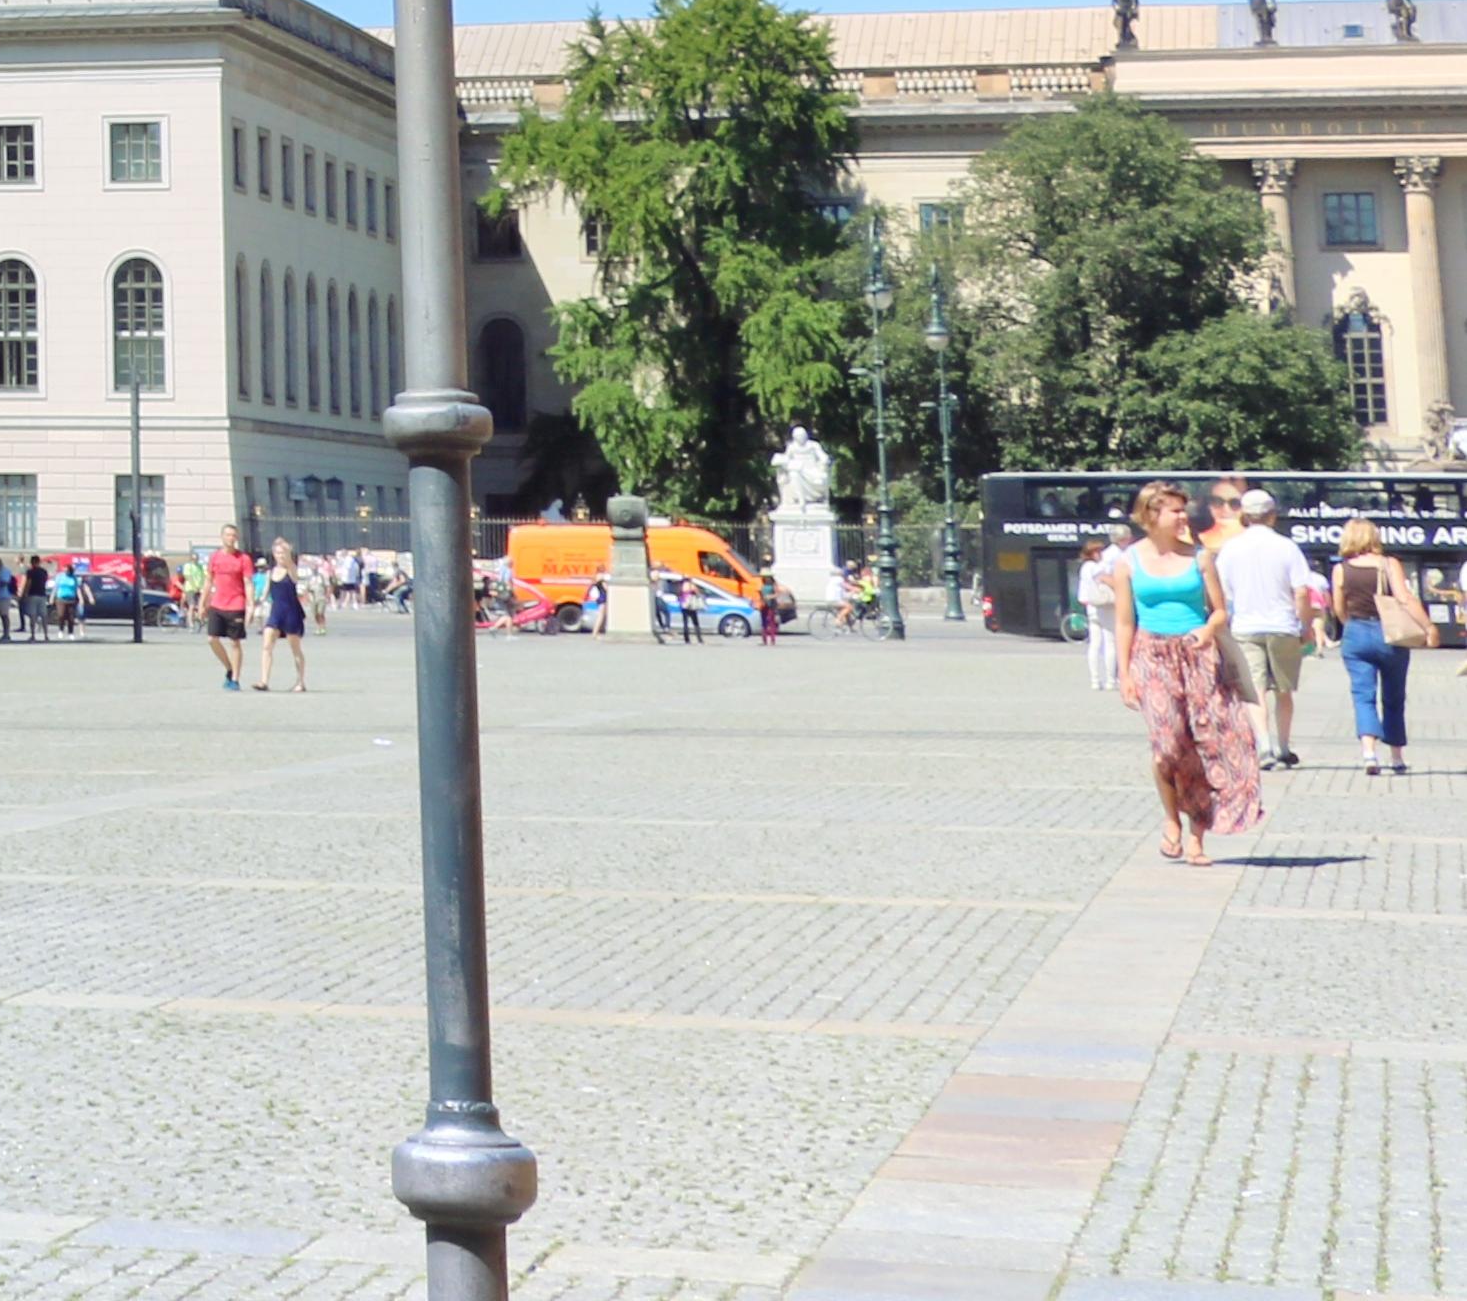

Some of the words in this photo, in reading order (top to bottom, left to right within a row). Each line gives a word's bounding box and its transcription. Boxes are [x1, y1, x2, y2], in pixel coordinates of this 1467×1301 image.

[1212, 119, 1426, 135] HUMBOLDT
[1003, 523, 1078, 534] POTSDAMER
[1079, 523, 1111, 534] PLAT
[1290, 525, 1426, 545] SHOING
[1432, 526, 1467, 545] AR
